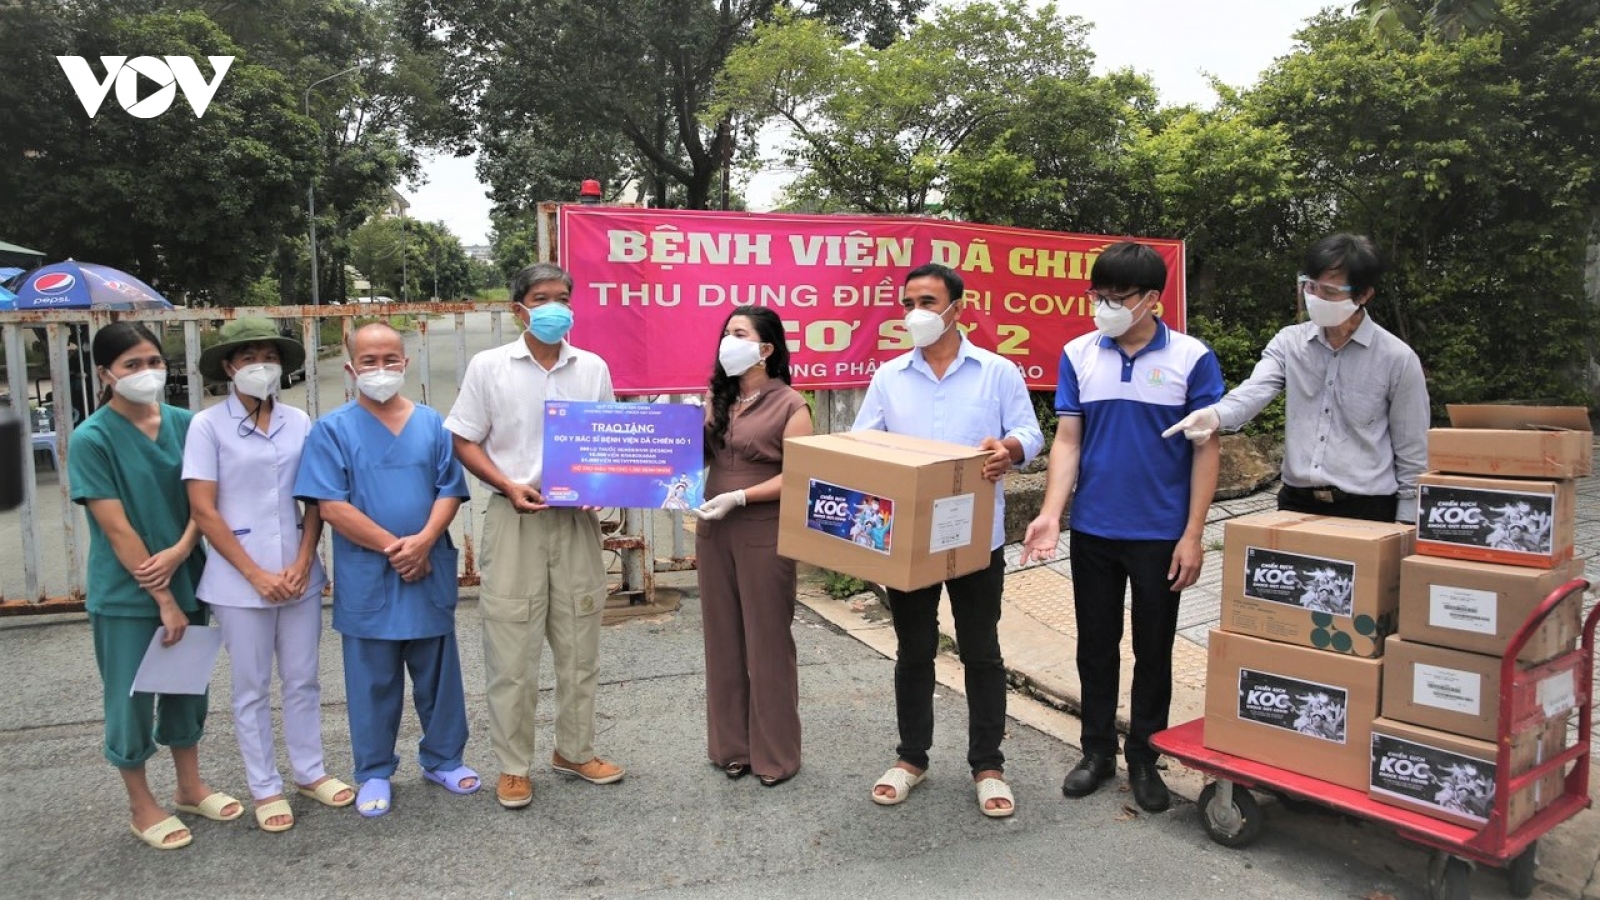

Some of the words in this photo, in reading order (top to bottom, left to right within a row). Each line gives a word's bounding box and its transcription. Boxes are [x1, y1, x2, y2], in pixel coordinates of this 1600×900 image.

[607, 224, 772, 270] BỆNH
[789, 230, 914, 273] VIỆN
[931, 238, 994, 273] DÃ
[33, 295, 71, 305] pepsi
[589, 283, 681, 306] THU
[698, 284, 818, 308] DUNG
[962, 288, 991, 316] RỊ
[996, 324, 1030, 355] 2
[591, 422, 622, 433] TRAO
[624, 422, 655, 435] TẶNG
[554, 434, 568, 443] ĐỘI
[575, 434, 591, 443] BÁC
[601, 435, 621, 445] BỆNH
[622, 435, 639, 446] VIỆN
[652, 435, 674, 445] CHIẾN
[814, 500, 849, 516] KOC
[1428, 507, 1482, 524] KOC
[1253, 568, 1297, 586] KOC
[1246, 690, 1290, 709] KOC
[1379, 756, 1430, 779] KOC
